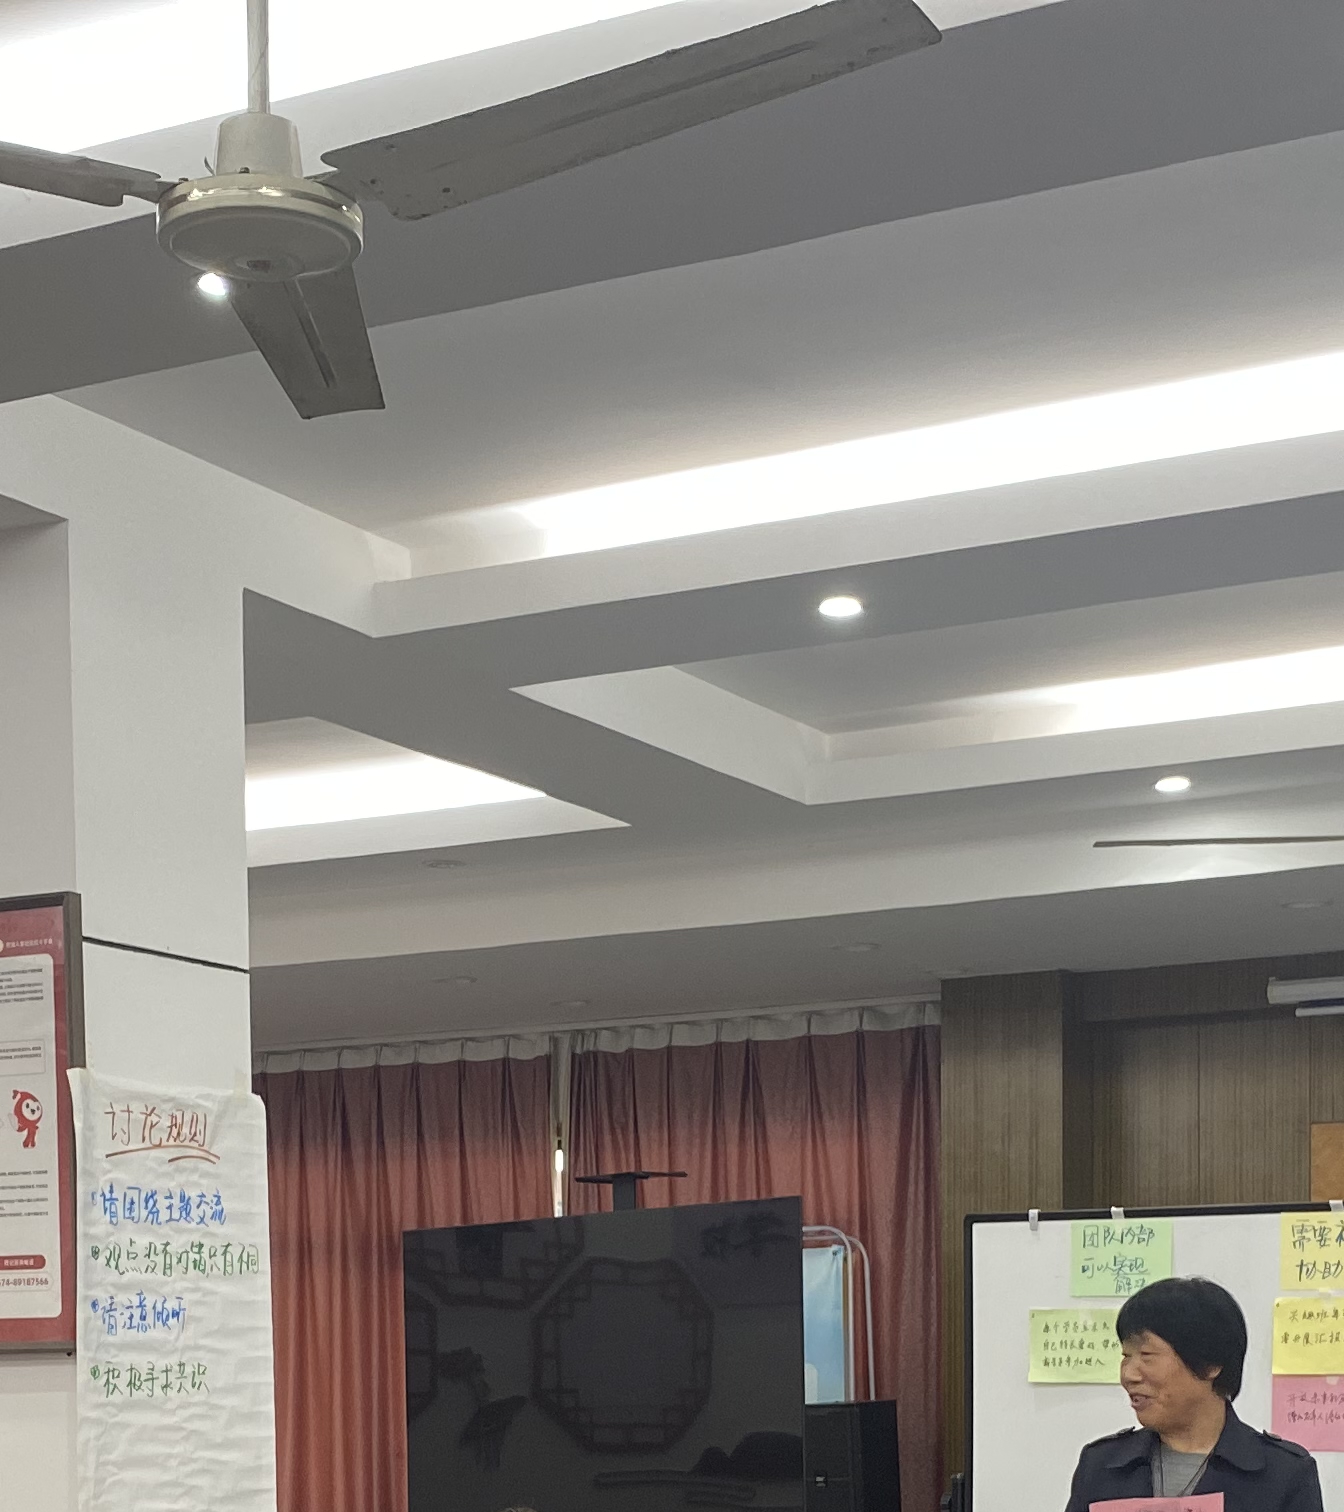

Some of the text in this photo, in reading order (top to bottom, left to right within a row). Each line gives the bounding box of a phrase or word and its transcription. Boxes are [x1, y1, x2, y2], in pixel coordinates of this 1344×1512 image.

[104, 1102, 207, 1147] 讨论规则
[1082, 1223, 1156, 1248] 团队内部
[1295, 1259, 1344, 1283] 协助
[100, 1289, 187, 1336] 请注意倾听
[103, 1360, 210, 1399] 积极寻求共识
